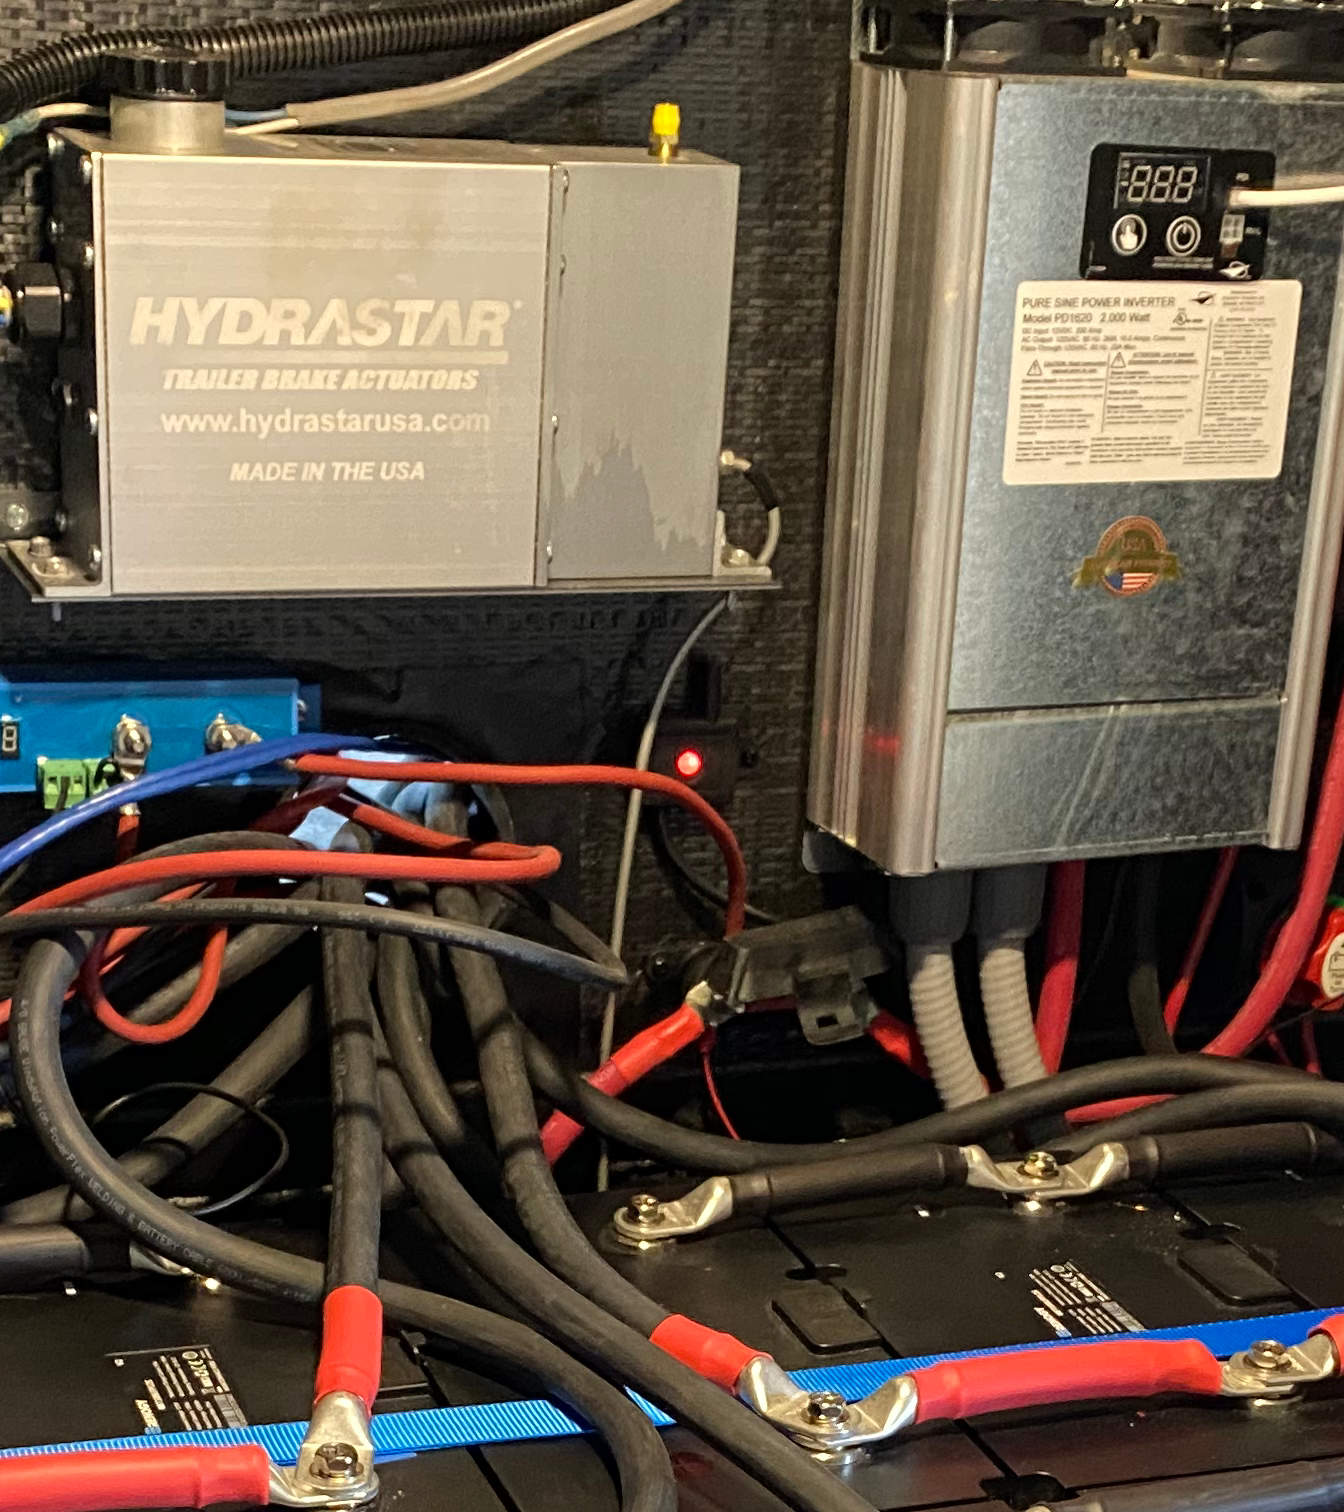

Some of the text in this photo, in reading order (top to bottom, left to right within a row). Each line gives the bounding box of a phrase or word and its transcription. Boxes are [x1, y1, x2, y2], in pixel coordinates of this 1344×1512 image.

[1022, 297, 1175, 308] PURE SINE POWER INVERTER
[129, 296, 513, 347] HYDRASTAR
[1023, 313, 1051, 323] Model
[1129, 313, 1150, 322] Watt
[162, 369, 479, 391] TRAILER BRAKE ACTUATORS
[160, 407, 491, 439] www.hydrastarusa.com
[229, 461, 426, 481] MADE IN THE USA
